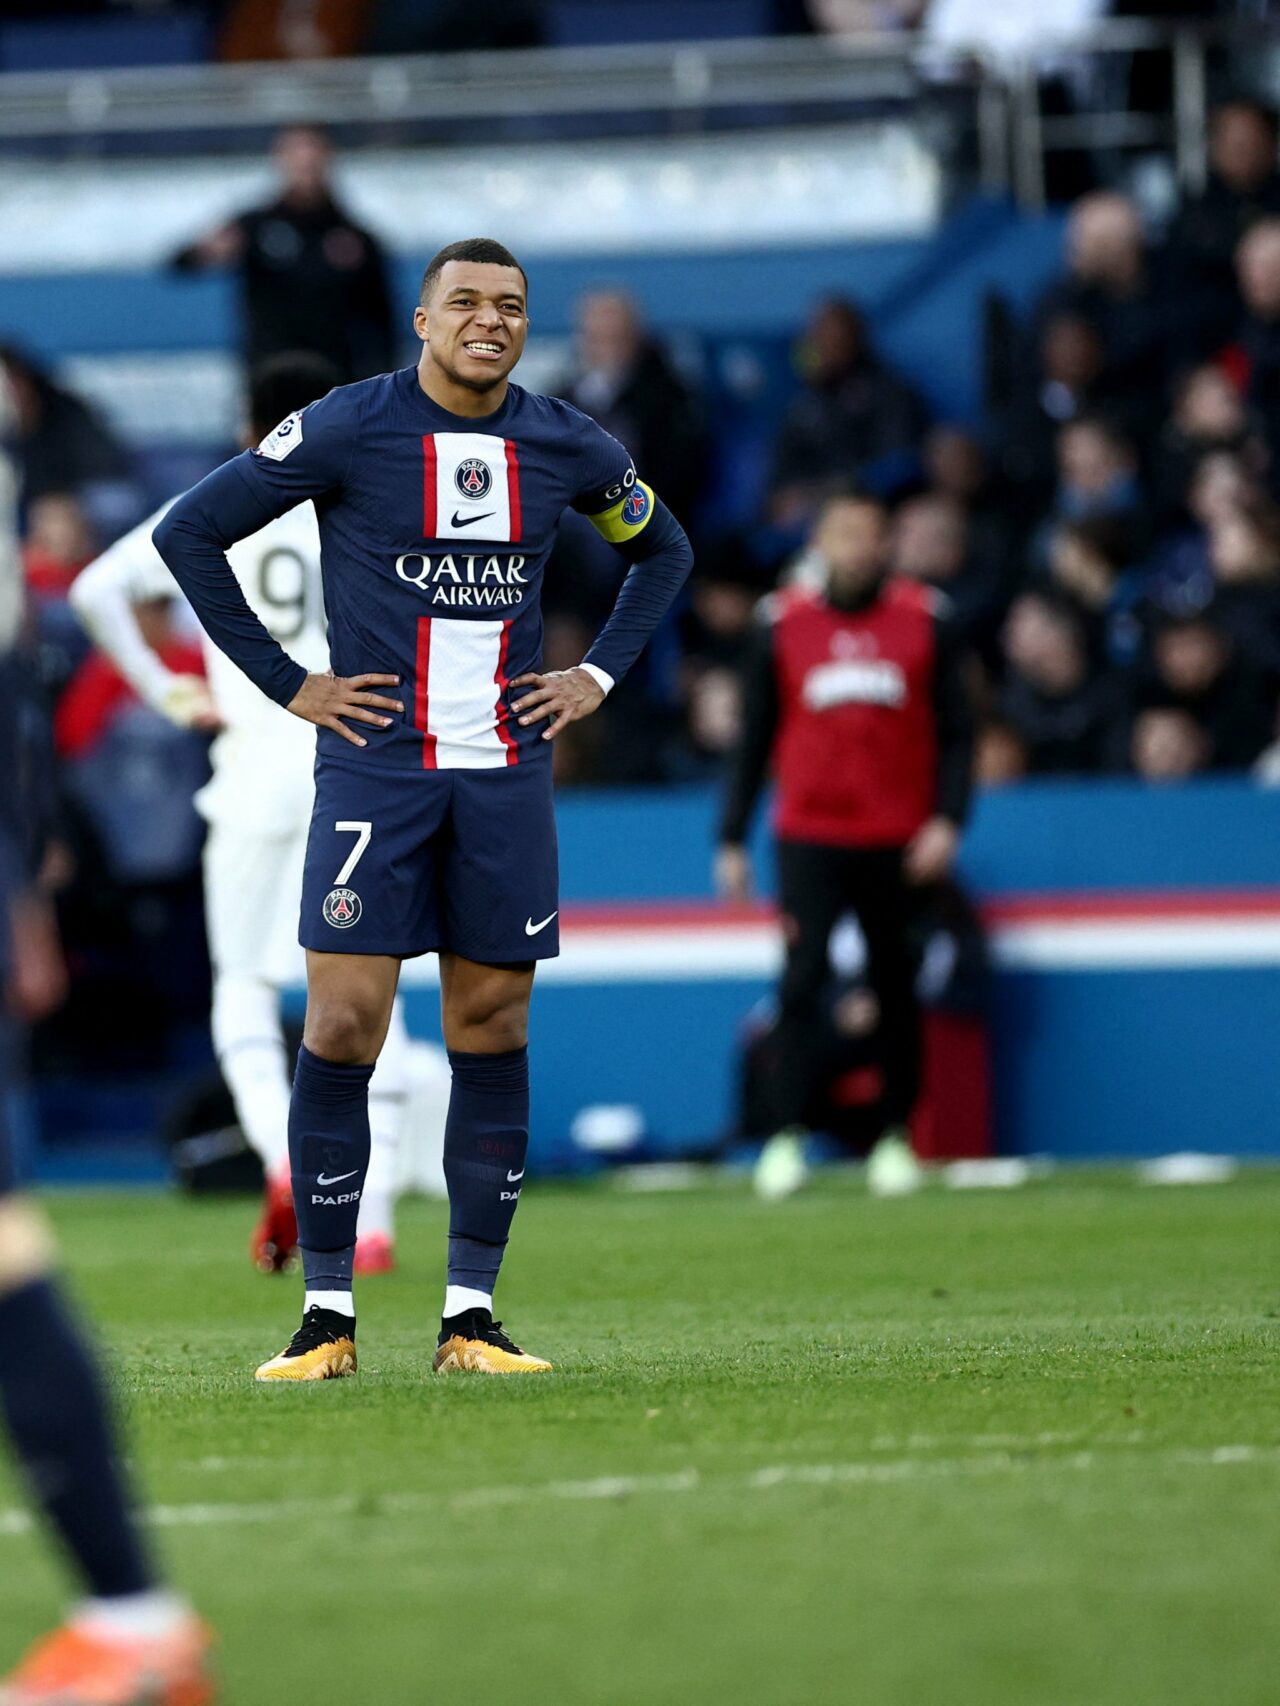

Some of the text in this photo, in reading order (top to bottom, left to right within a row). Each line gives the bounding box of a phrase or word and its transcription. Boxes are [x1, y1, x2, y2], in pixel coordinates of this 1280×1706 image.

[461, 461, 486, 472] PARIS
[395, 553, 529, 590] QATAR
[258, 547, 306, 642] 9
[431, 585, 523, 606] AIRWAYS
[333, 821, 373, 885] 7
[330, 890, 357, 902] PARIS
[311, 1190, 360, 1205] PARIS
